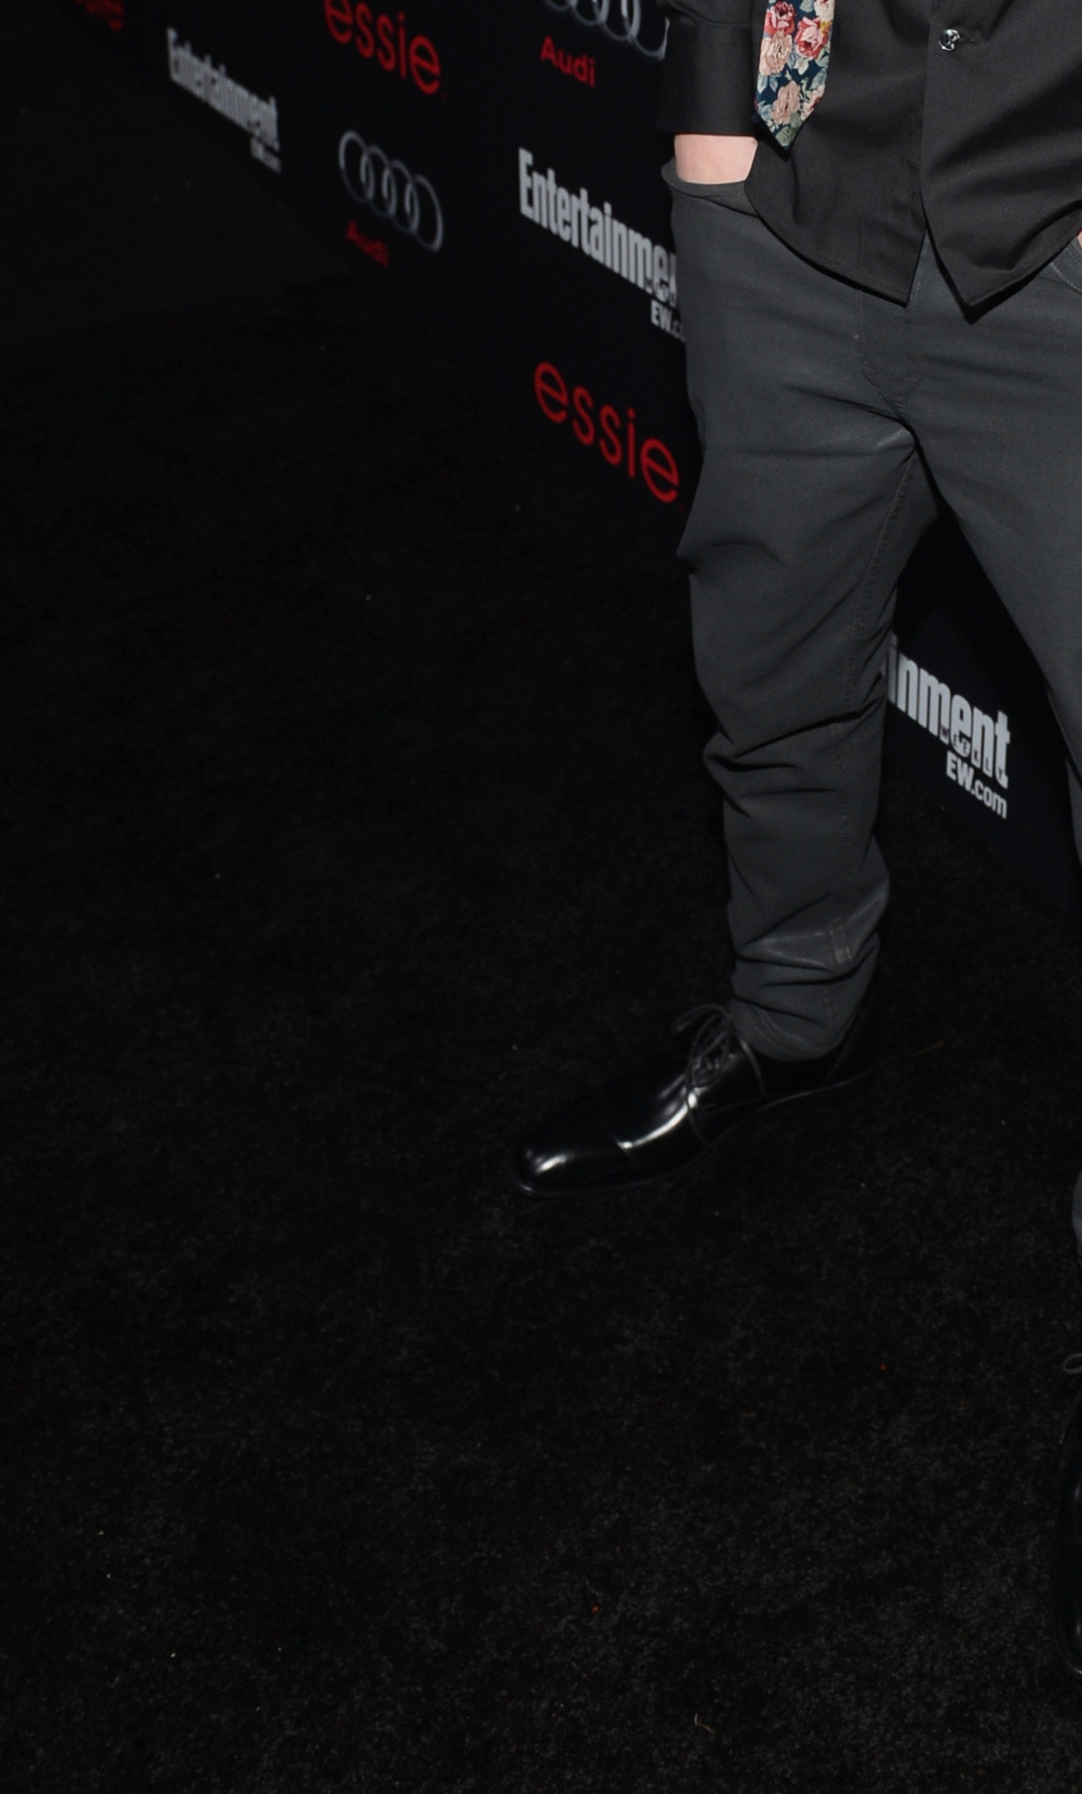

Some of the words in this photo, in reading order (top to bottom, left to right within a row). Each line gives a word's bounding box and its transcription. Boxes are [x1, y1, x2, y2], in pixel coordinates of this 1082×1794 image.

[540, 35, 596, 87] Audi
[534, 362, 679, 503] essie
[946, 750, 1007, 819] EW.com
